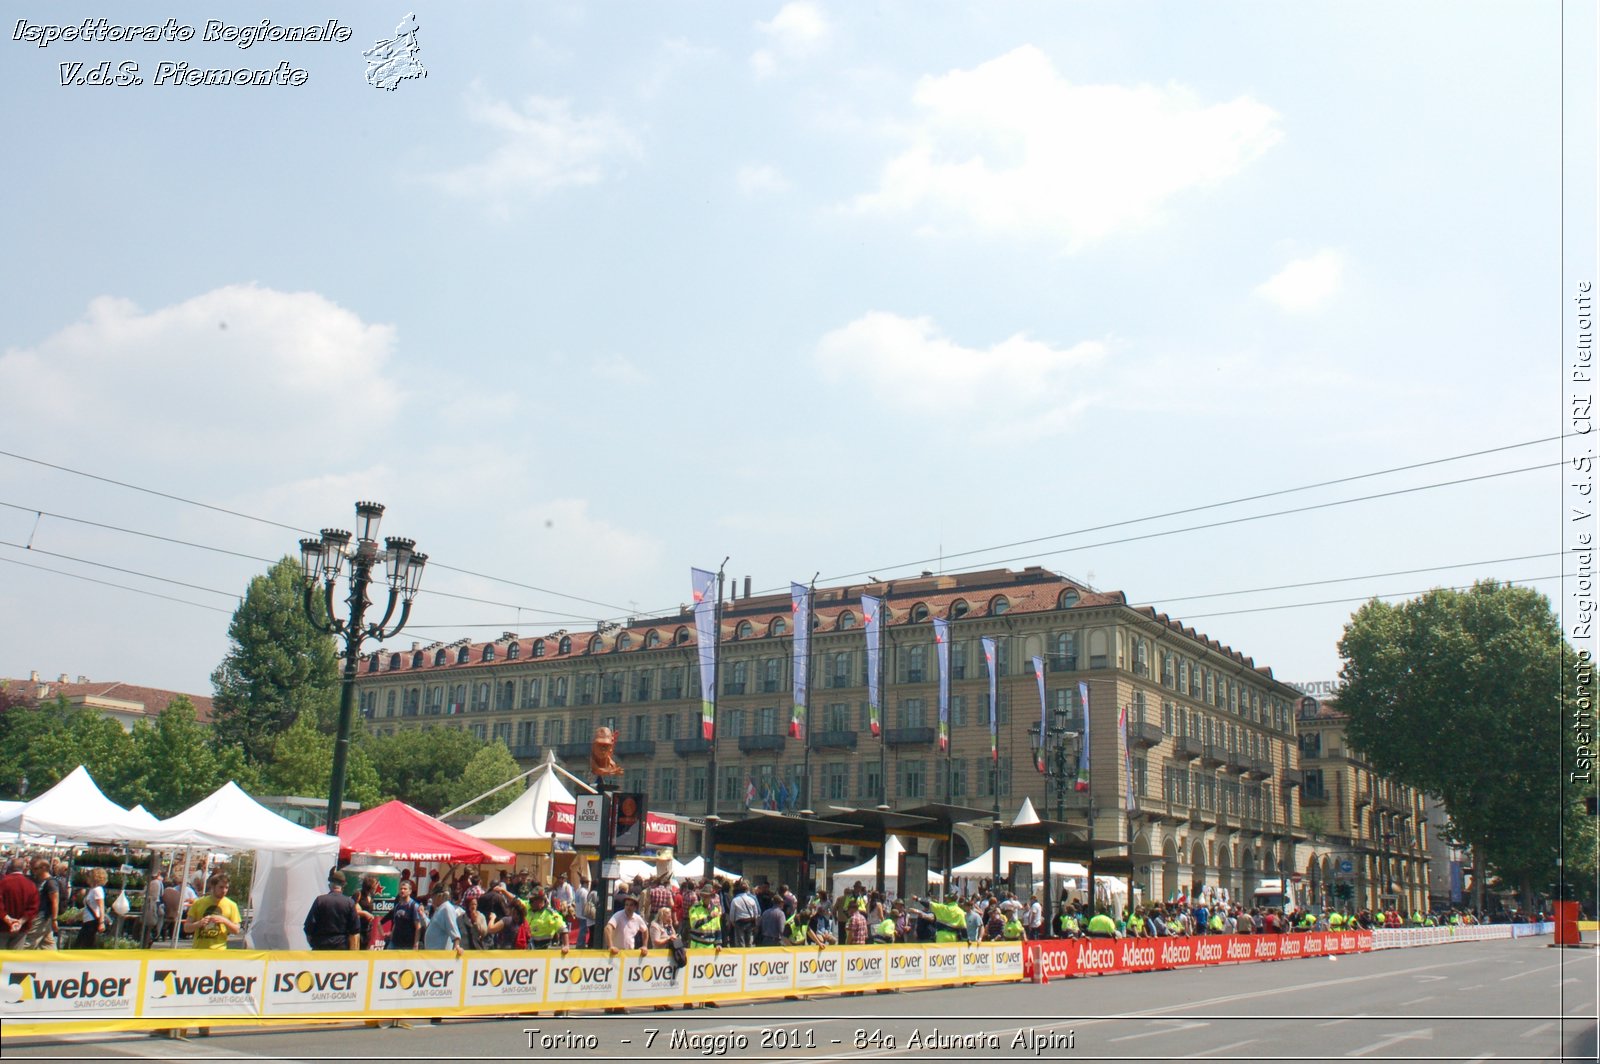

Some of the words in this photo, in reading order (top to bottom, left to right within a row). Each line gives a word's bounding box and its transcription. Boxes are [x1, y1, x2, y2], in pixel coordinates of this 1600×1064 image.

[410, 853, 452, 861] MORETTI
[1195, 938, 1222, 961] Adecco
[1227, 938, 1251, 958] Adecco
[1254, 937, 1277, 957] Adecco
[1280, 936, 1300, 955] Adecco
[1303, 935, 1322, 952] Adecco
[1324, 934, 1339, 951] Adecco
[1341, 933, 1356, 950] Adecco
[1025, 945, 1068, 973] Aecco
[1077, 942, 1115, 969] Adecco
[1122, 940, 1155, 967] Adecco
[1161, 940, 1191, 964] Adecco
[33, 971, 131, 1000] weber
[174, 969, 257, 995] weber
[311, 991, 357, 1000] SAINT-GOBAIN
[412, 988, 453, 997] SAINT-GOBAIN
[73, 999, 129, 1008] SAINT-GOBAIN
